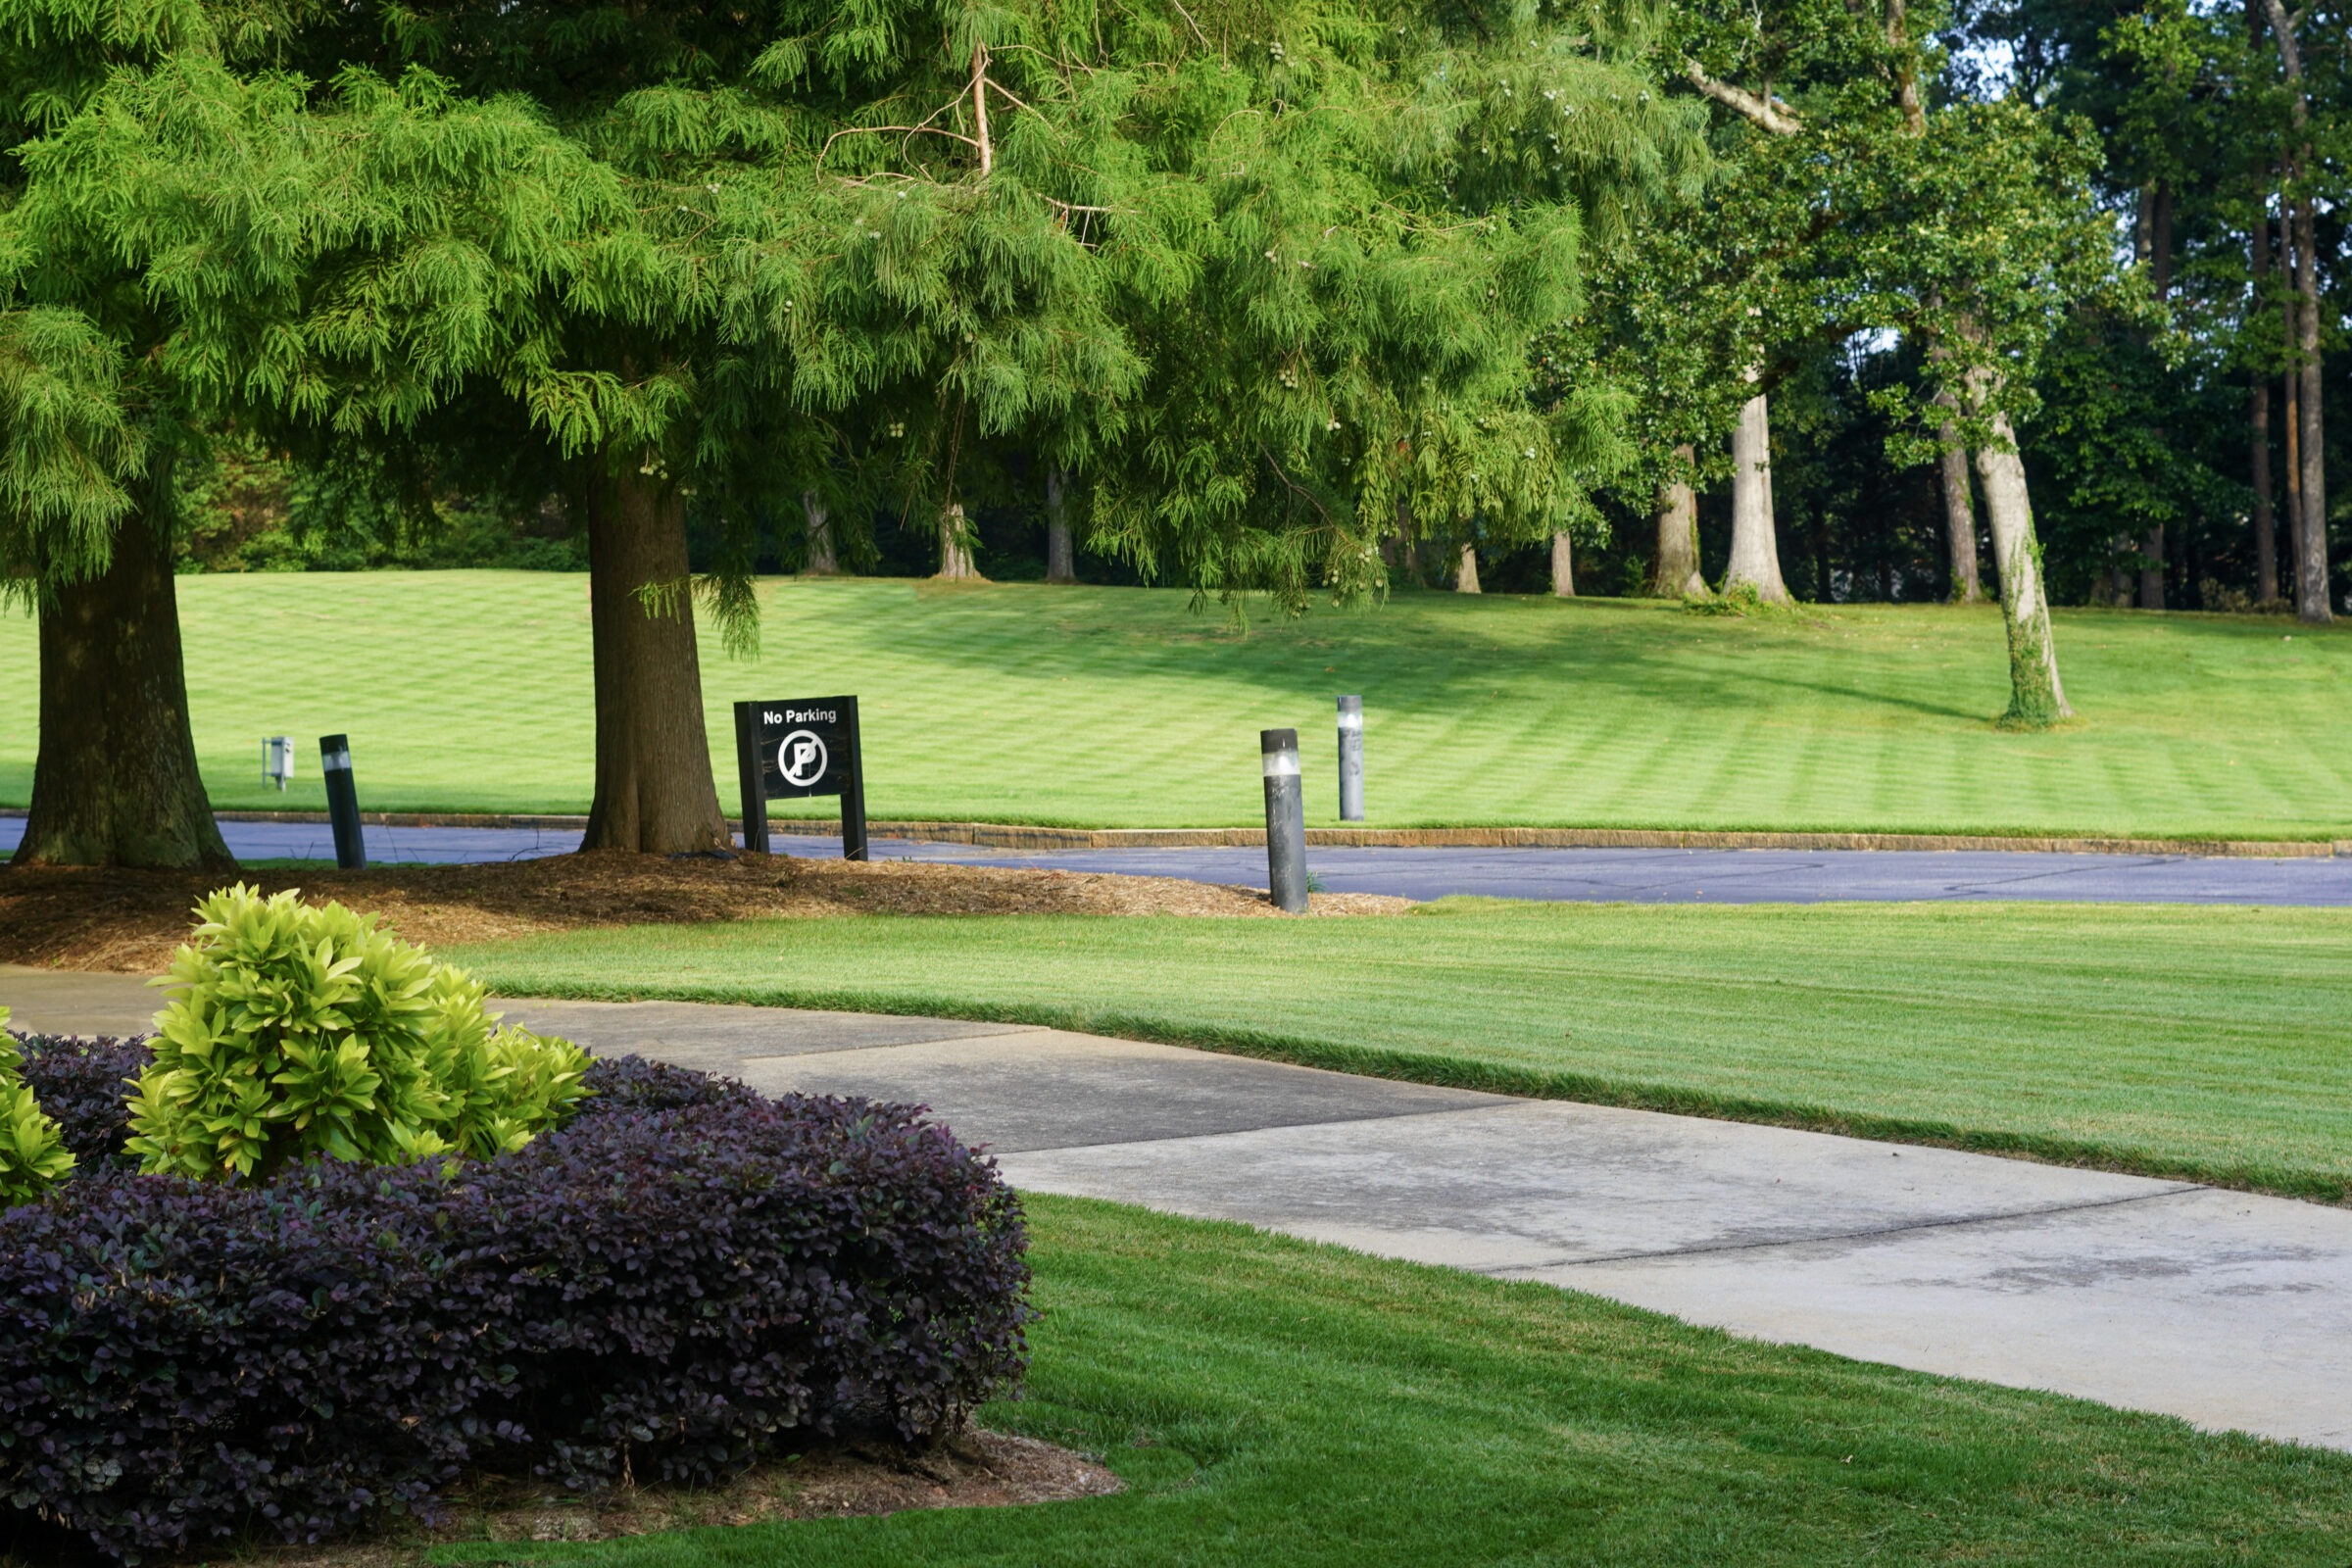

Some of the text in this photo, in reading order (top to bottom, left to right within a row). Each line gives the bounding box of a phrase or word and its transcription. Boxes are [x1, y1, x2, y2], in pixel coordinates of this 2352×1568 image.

[763, 708, 837, 724] No Parking
[794, 742, 816, 776] P
